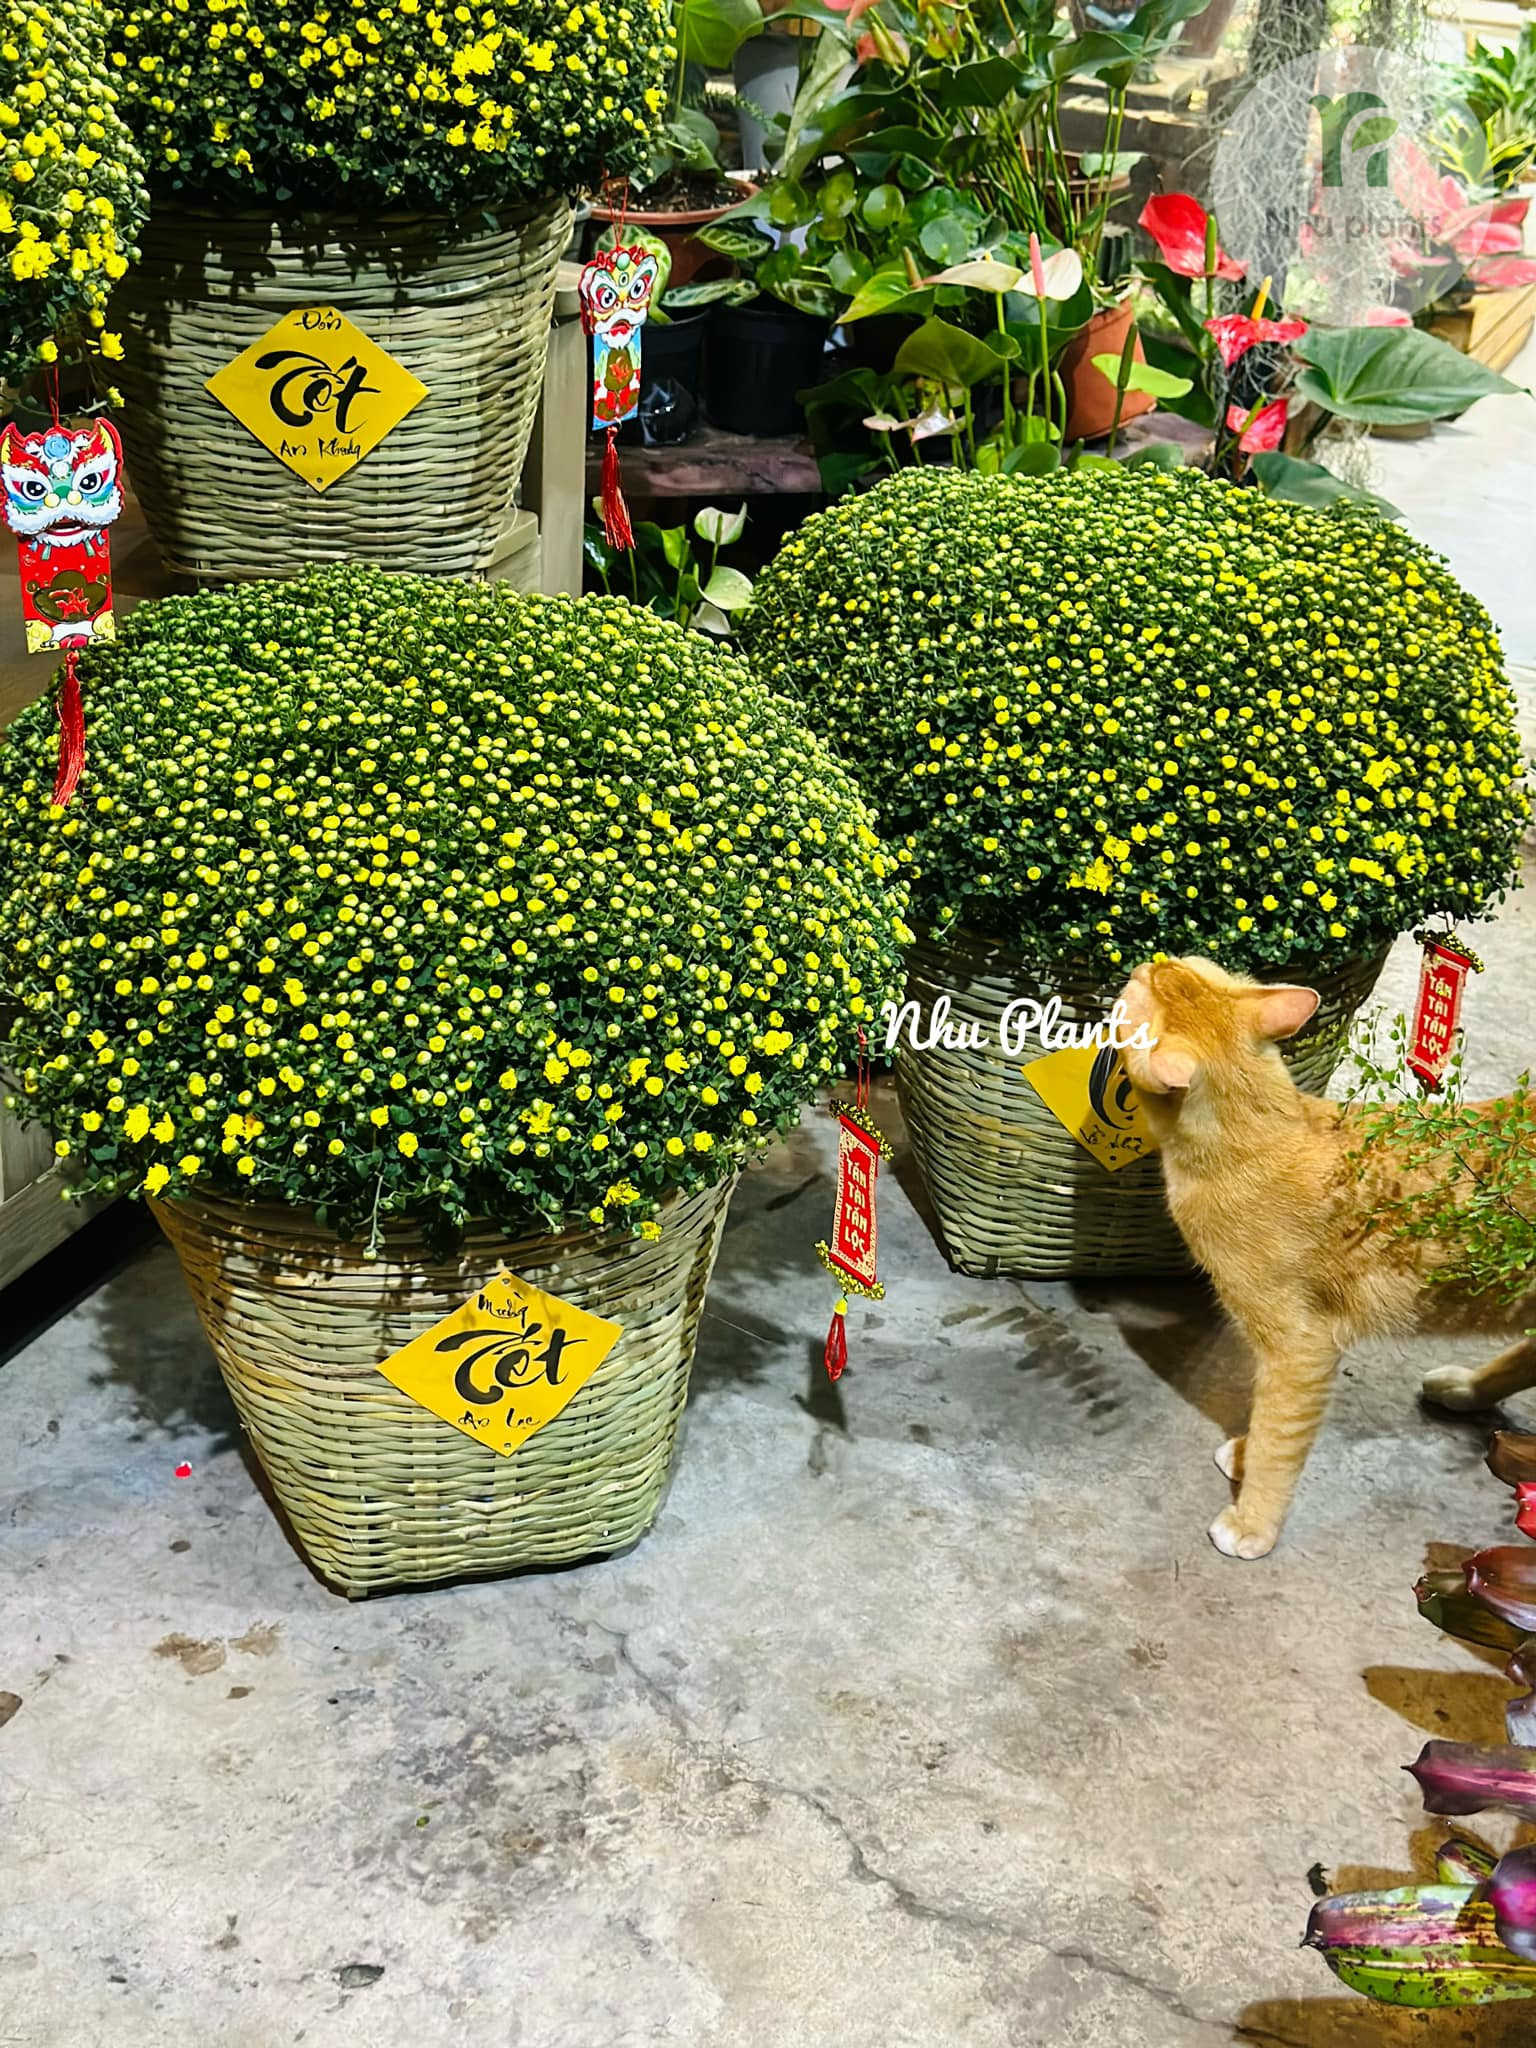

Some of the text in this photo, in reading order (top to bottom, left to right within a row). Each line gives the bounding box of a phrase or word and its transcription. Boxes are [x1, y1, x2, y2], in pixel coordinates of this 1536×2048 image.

[254, 350, 381, 434] Tết
[279, 439, 307, 456] An
[1427, 995, 1449, 1017] TÀI
[1421, 1034, 1444, 1057] LỘC
[847, 1181, 866, 1209] TÀI
[844, 1226, 866, 1254] LỘC
[434, 1323, 588, 1405] Tết
